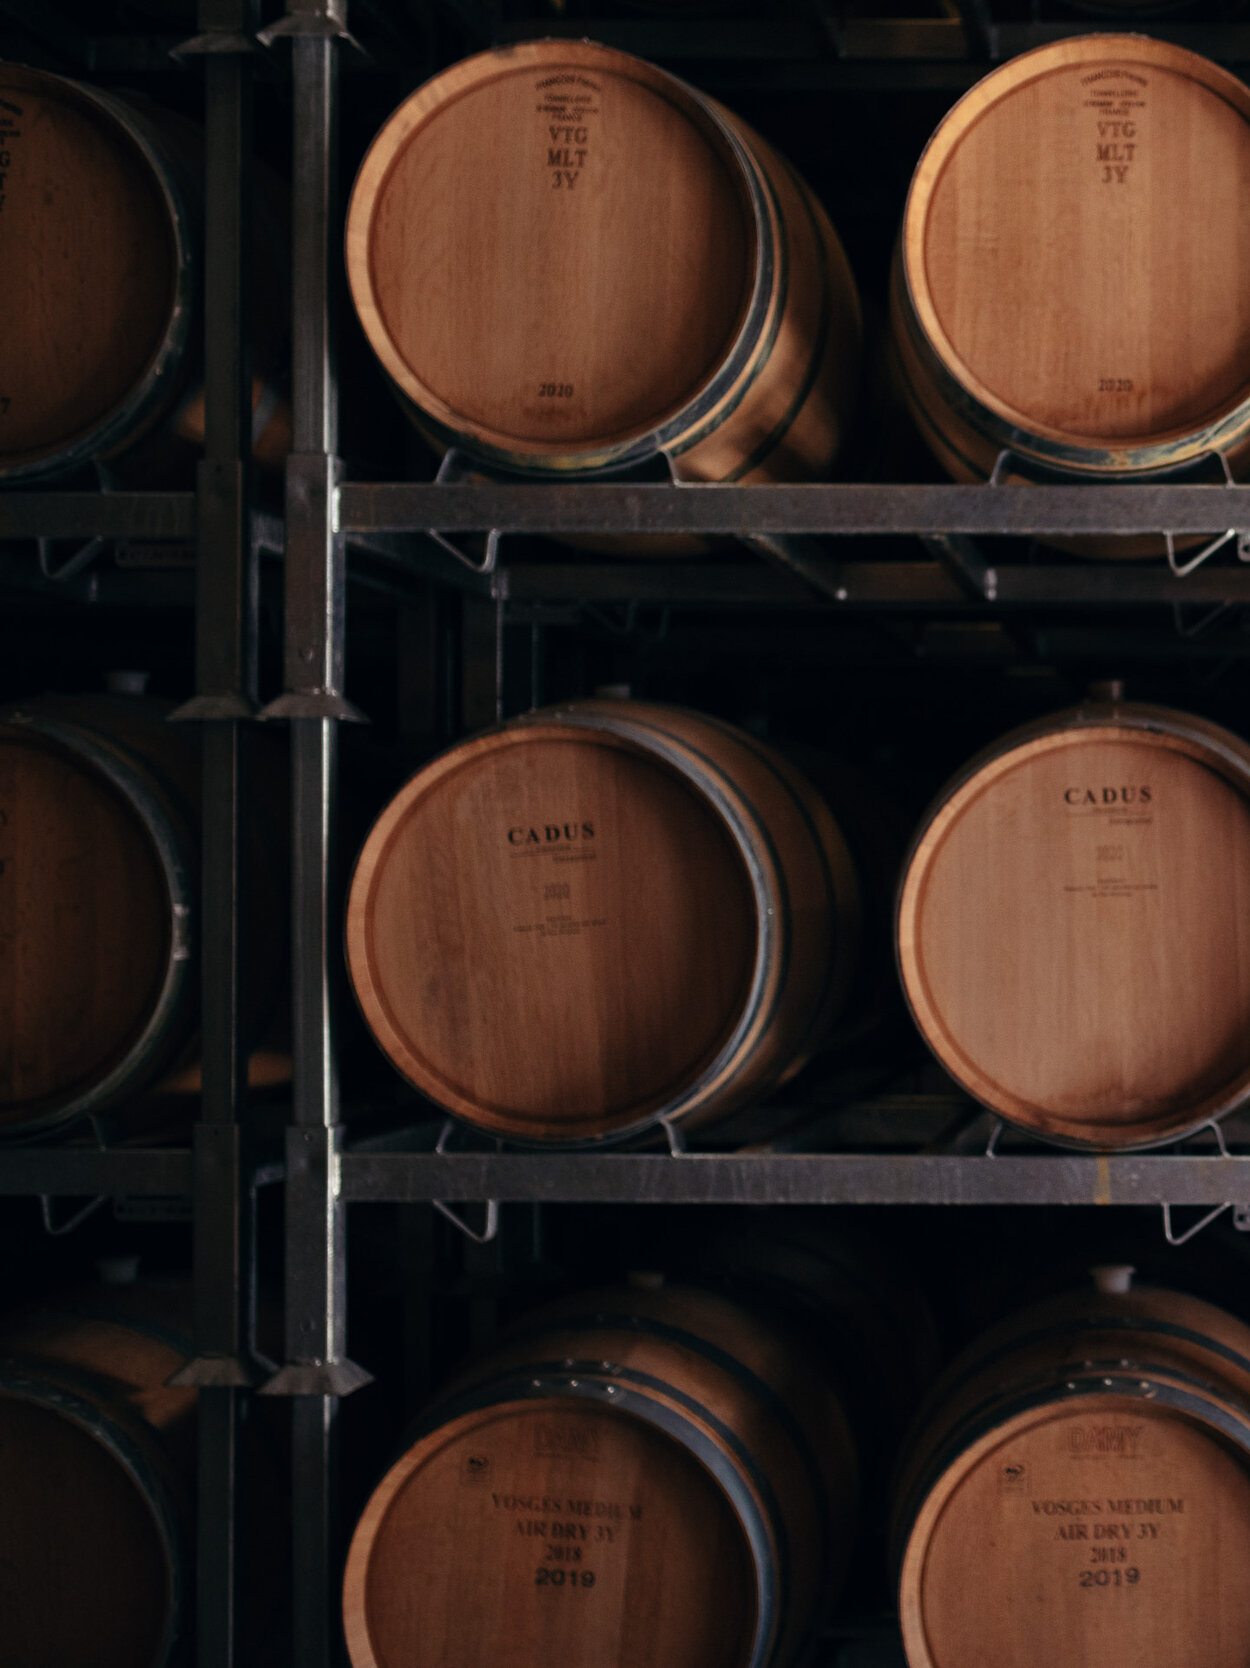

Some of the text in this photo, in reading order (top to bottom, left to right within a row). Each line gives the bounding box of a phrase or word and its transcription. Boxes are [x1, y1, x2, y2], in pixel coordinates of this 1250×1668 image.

[549, 126, 588, 144] VTG
[1096, 121, 1137, 138] VTG
[548, 149, 587, 168] MLT
[1096, 144, 1136, 162] MLT
[552, 171, 578, 190] 3Y
[1102, 166, 1129, 184] 3Y
[1098, 378, 1134, 392] 2020
[1064, 785, 1152, 805] CADUS
[507, 821, 595, 846] CADUS
[492, 1492, 643, 1520] VOSGES MEDIUM
[1031, 1498, 1185, 1515] VOSGES MEDIUM
[517, 1520, 616, 1543] AIR DRY 3Y
[1055, 1523, 1160, 1541] AIR DRY 3Y
[545, 1544, 582, 1562] 2018
[1090, 1546, 1128, 1563] 2018
[535, 1568, 596, 1587] 2019
[1079, 1567, 1140, 1588] 2019
